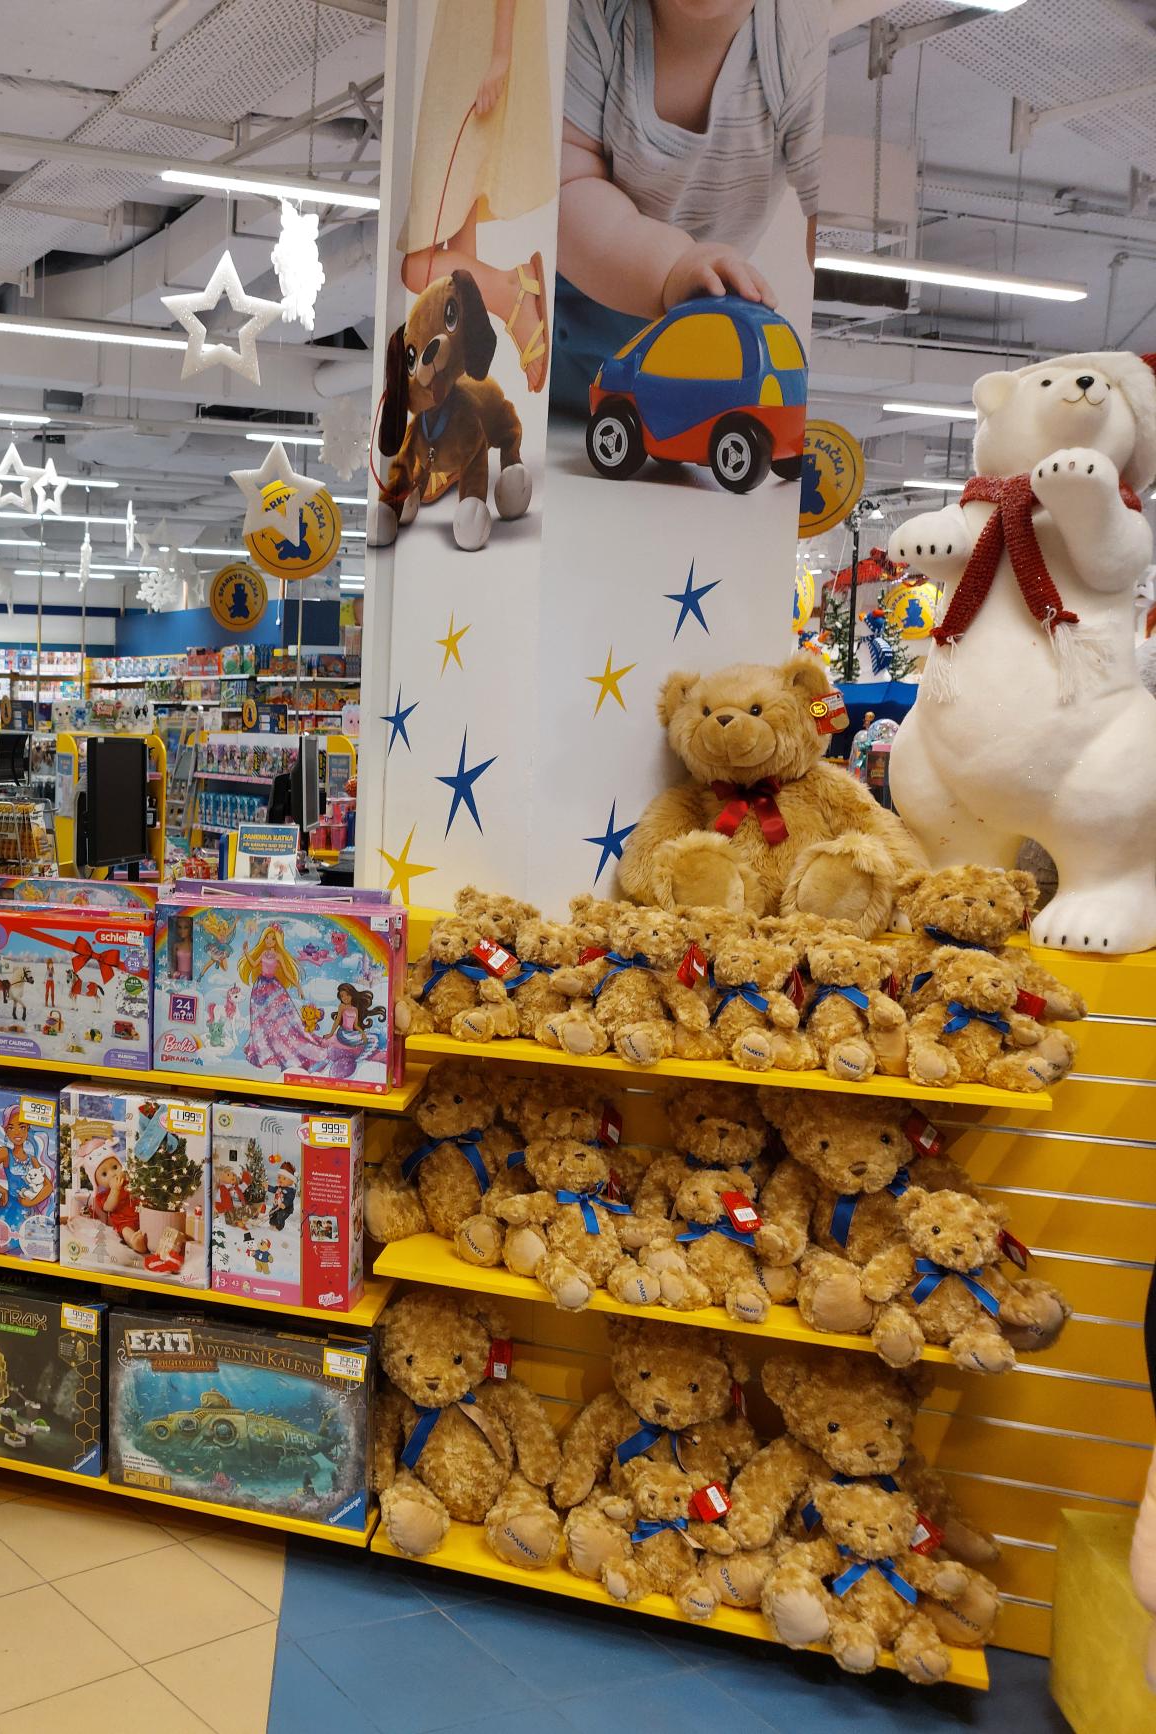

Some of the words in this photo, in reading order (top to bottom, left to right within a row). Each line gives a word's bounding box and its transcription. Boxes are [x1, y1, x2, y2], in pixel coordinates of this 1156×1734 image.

[815, 438, 844, 476] KAČKA
[100, 932, 128, 943] schlei
[176, 999, 191, 1011] 24
[463, 1018, 483, 1035] SPARKYS
[8, 1039, 34, 1048] CALENDAR
[164, 1034, 196, 1053] Barbie
[626, 1034, 641, 1059] SPARKYS
[742, 1044, 765, 1058] SPARKYS
[838, 1055, 860, 1071] SPARKYS
[321, 1122, 340, 1134] 999
[464, 1230, 485, 1258] SPARKYS
[636, 1279, 648, 1303] SPARKYS
[129, 1331, 189, 1353] EXIT
[194, 1340, 265, 1365] ADVENTNÍ
[267, 1352, 337, 1383] KALEND
[328, 1496, 362, 1525] Ravensburger
[504, 1527, 540, 1560] SPARKYS
